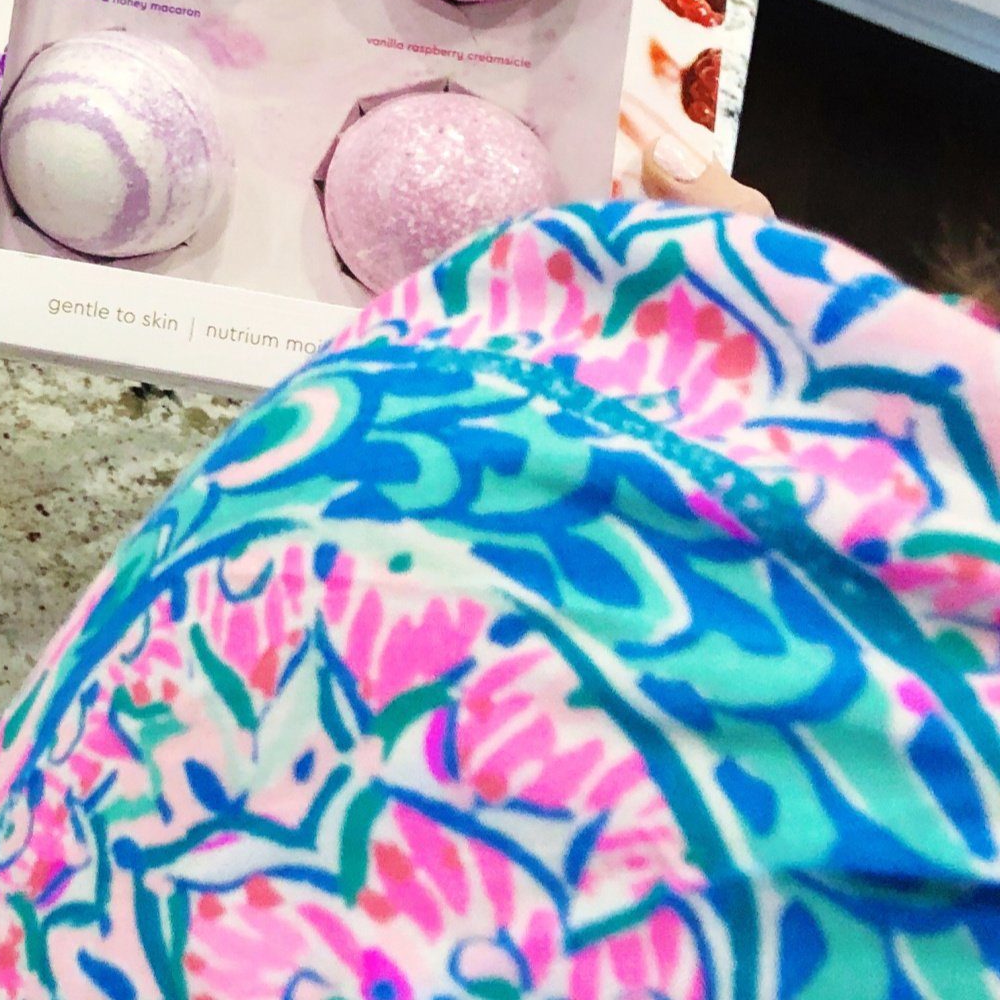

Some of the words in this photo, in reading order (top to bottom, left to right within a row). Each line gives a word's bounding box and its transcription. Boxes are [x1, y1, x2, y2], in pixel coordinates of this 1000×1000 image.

[150, 2, 201, 18] macaron
[366, 37, 405, 50] vanilla
[407, 44, 464, 61] raspberry
[466, 51, 533, 69] creamsicle
[48, 297, 110, 320] gentle
[116, 308, 136, 325] to
[142, 311, 179, 332] skin
[206, 323, 280, 348] nutrium
